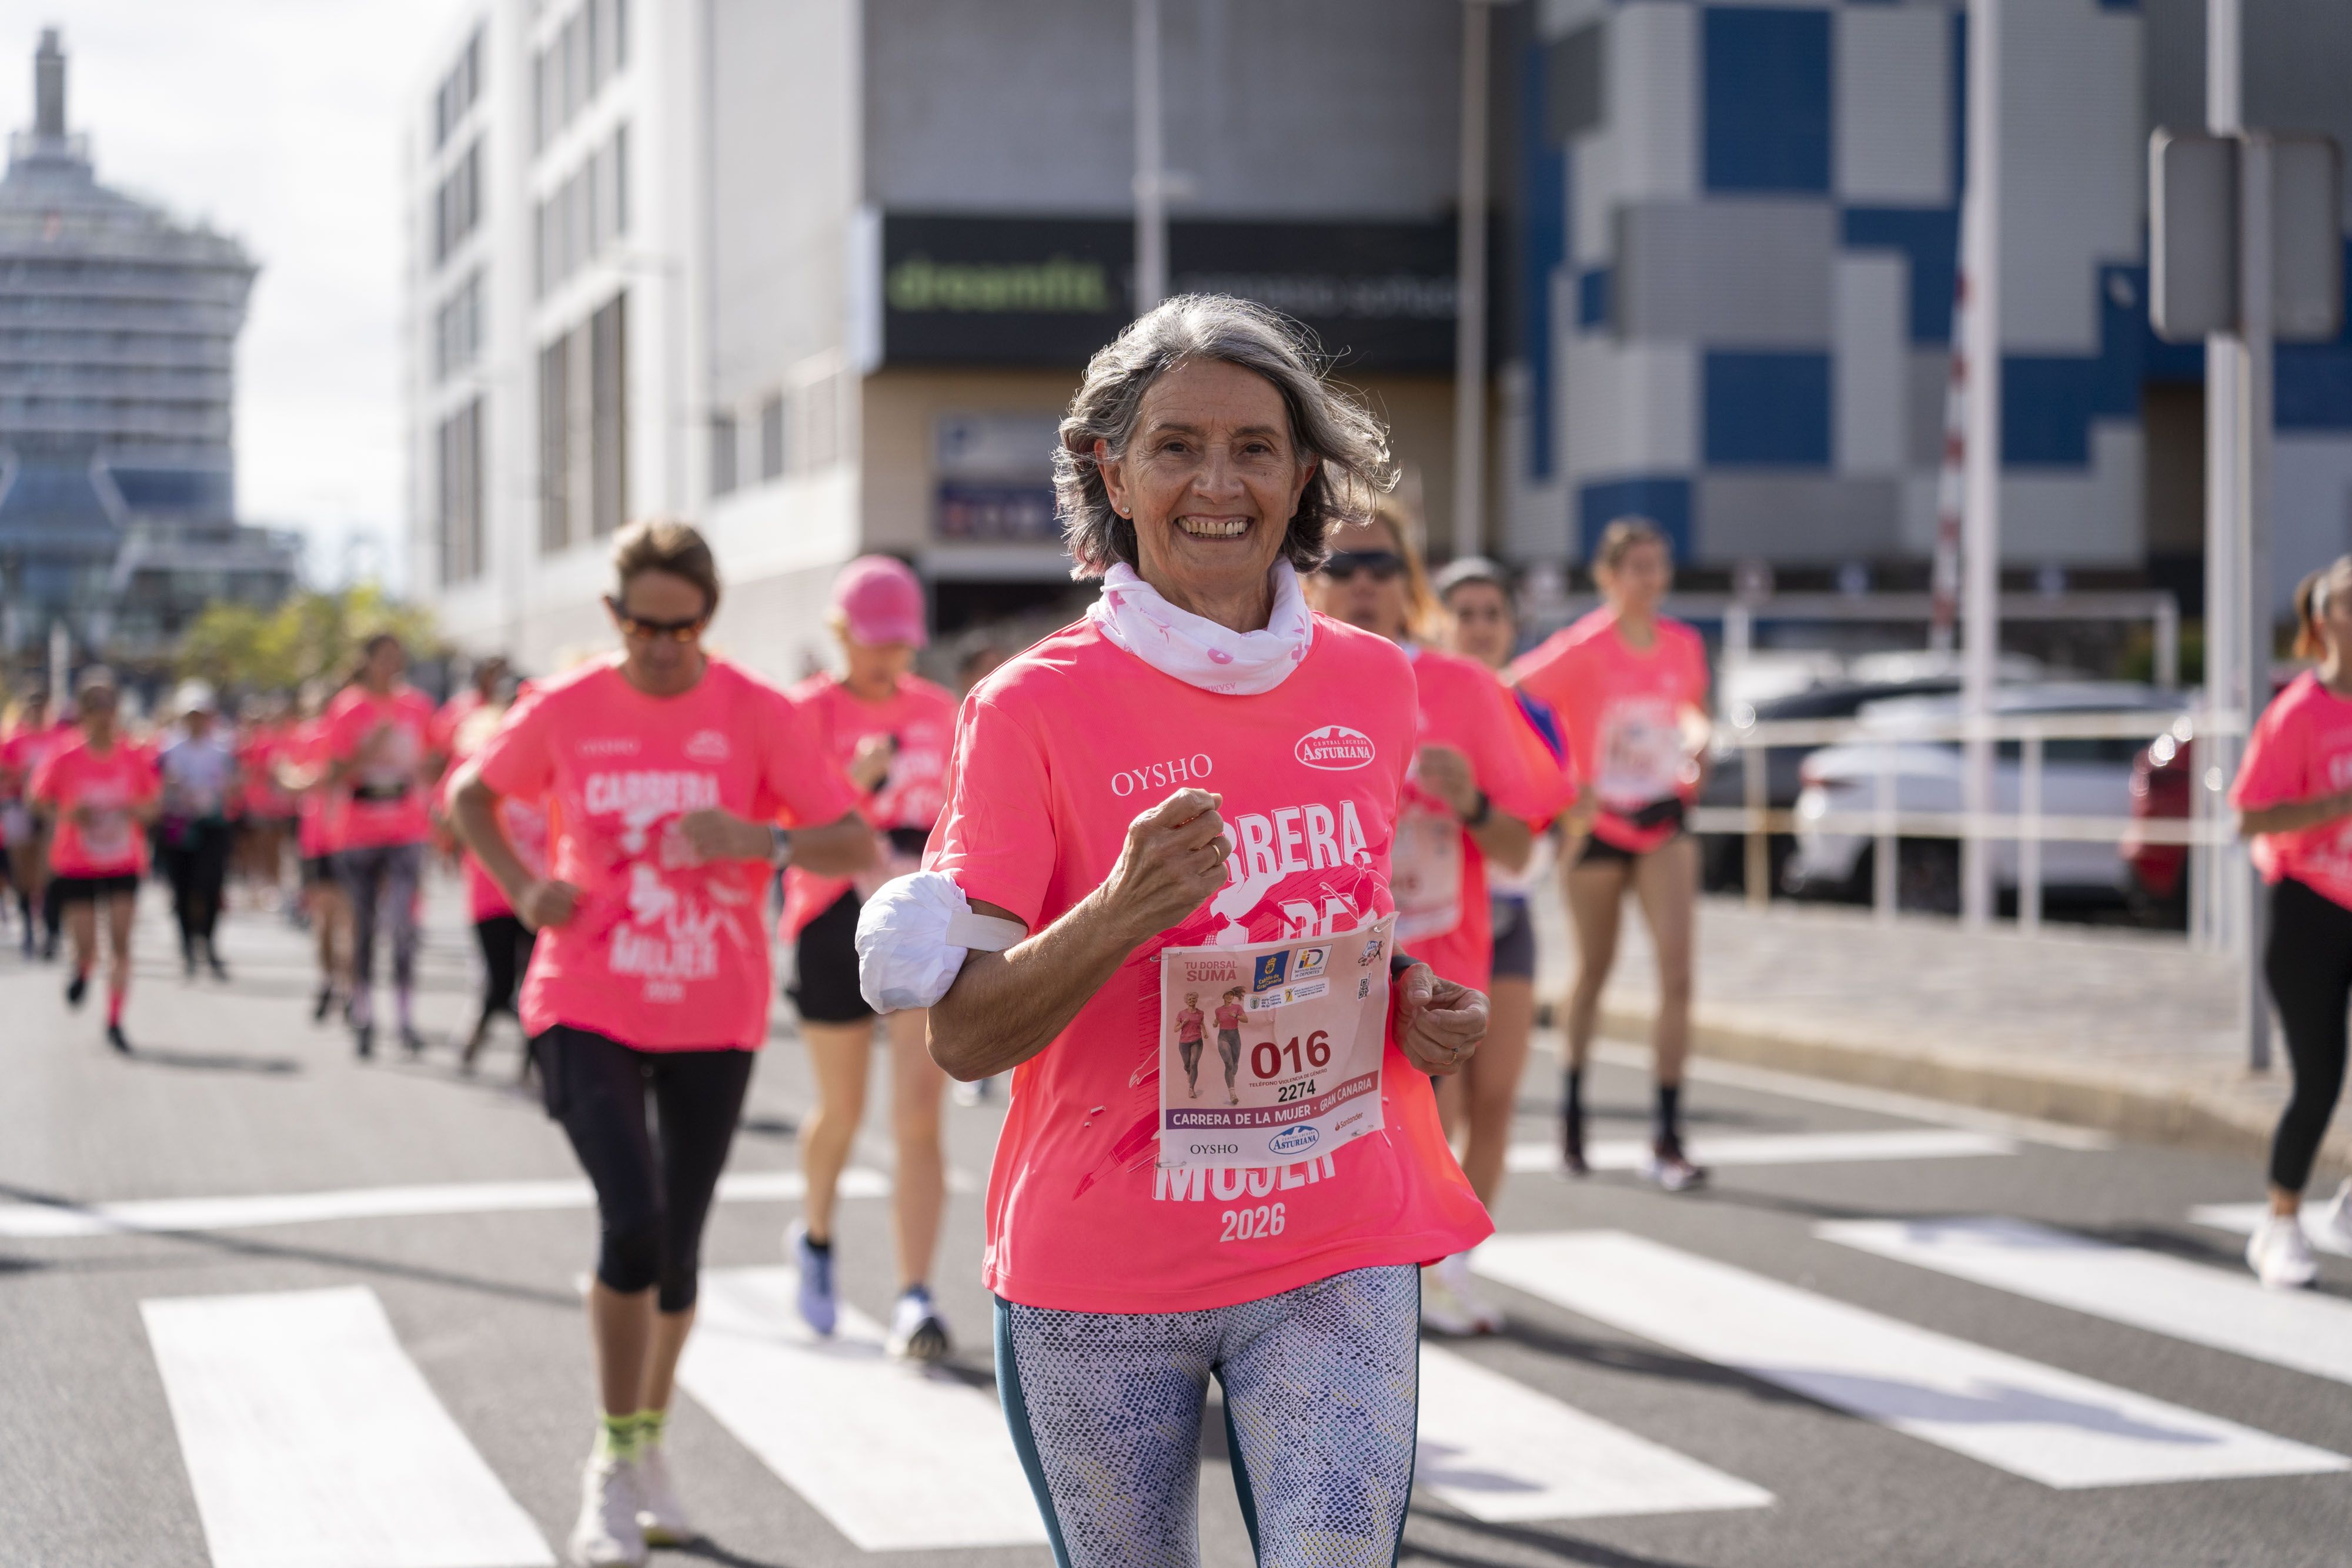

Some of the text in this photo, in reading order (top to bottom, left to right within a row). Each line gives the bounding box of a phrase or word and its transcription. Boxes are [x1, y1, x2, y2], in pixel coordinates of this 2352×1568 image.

[1303, 743, 1371, 761] ASTURIANA
[1111, 754, 1212, 796] OYSHO
[1185, 961, 1237, 969] TU DORSAL
[1187, 969, 1237, 982] SUMA
[1251, 1030, 1331, 1079] 016
[1278, 1075, 1304, 1085] VIOLENCIA
[1310, 1068, 1327, 1077] GÉNERO
[1278, 1079, 1316, 1103] 2274
[1173, 1077, 1372, 1126] CARRERA DE LA MUJER GRAN CANARIA
[1340, 1111, 1364, 1129] Santander
[1190, 1144, 1238, 1154] OYSHO
[1274, 1135, 1317, 1151] ASTURIANA
[1220, 1202, 1285, 1242] 2026
